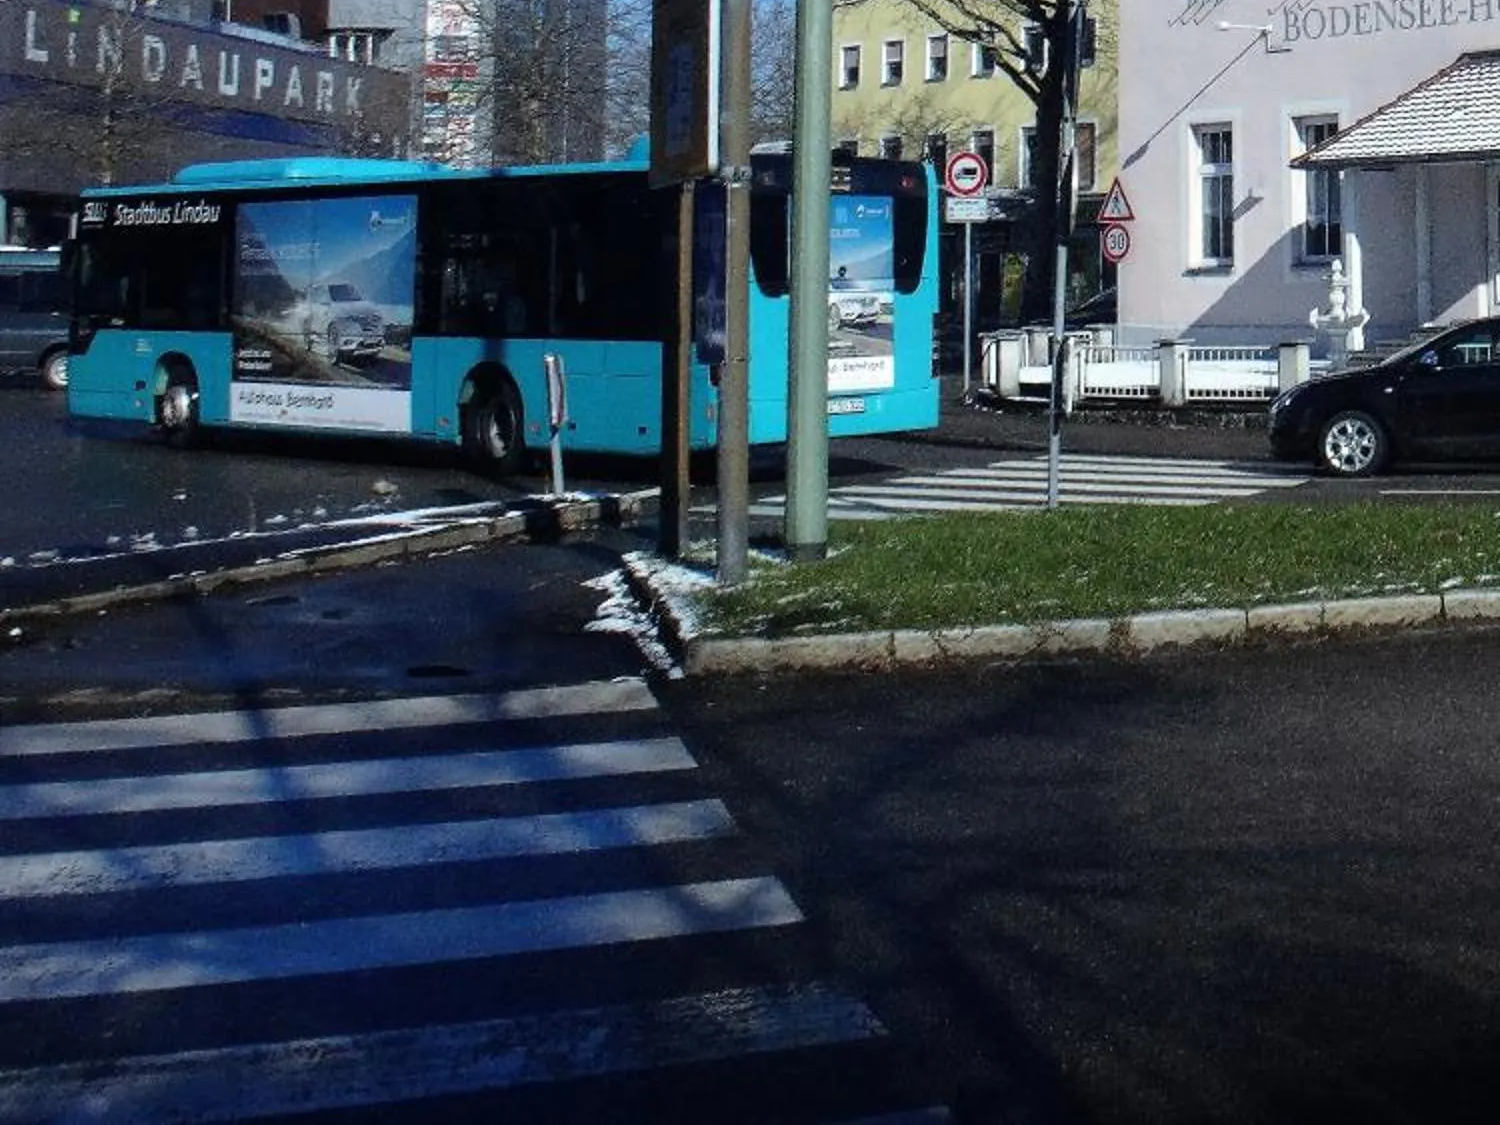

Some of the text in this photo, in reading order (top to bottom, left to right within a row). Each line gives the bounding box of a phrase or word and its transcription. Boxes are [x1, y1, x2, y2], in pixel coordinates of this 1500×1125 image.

[113, 201, 171, 226] Stadtbus
[171, 199, 221, 224] Lindau
[1109, 233, 1125, 250] 30
